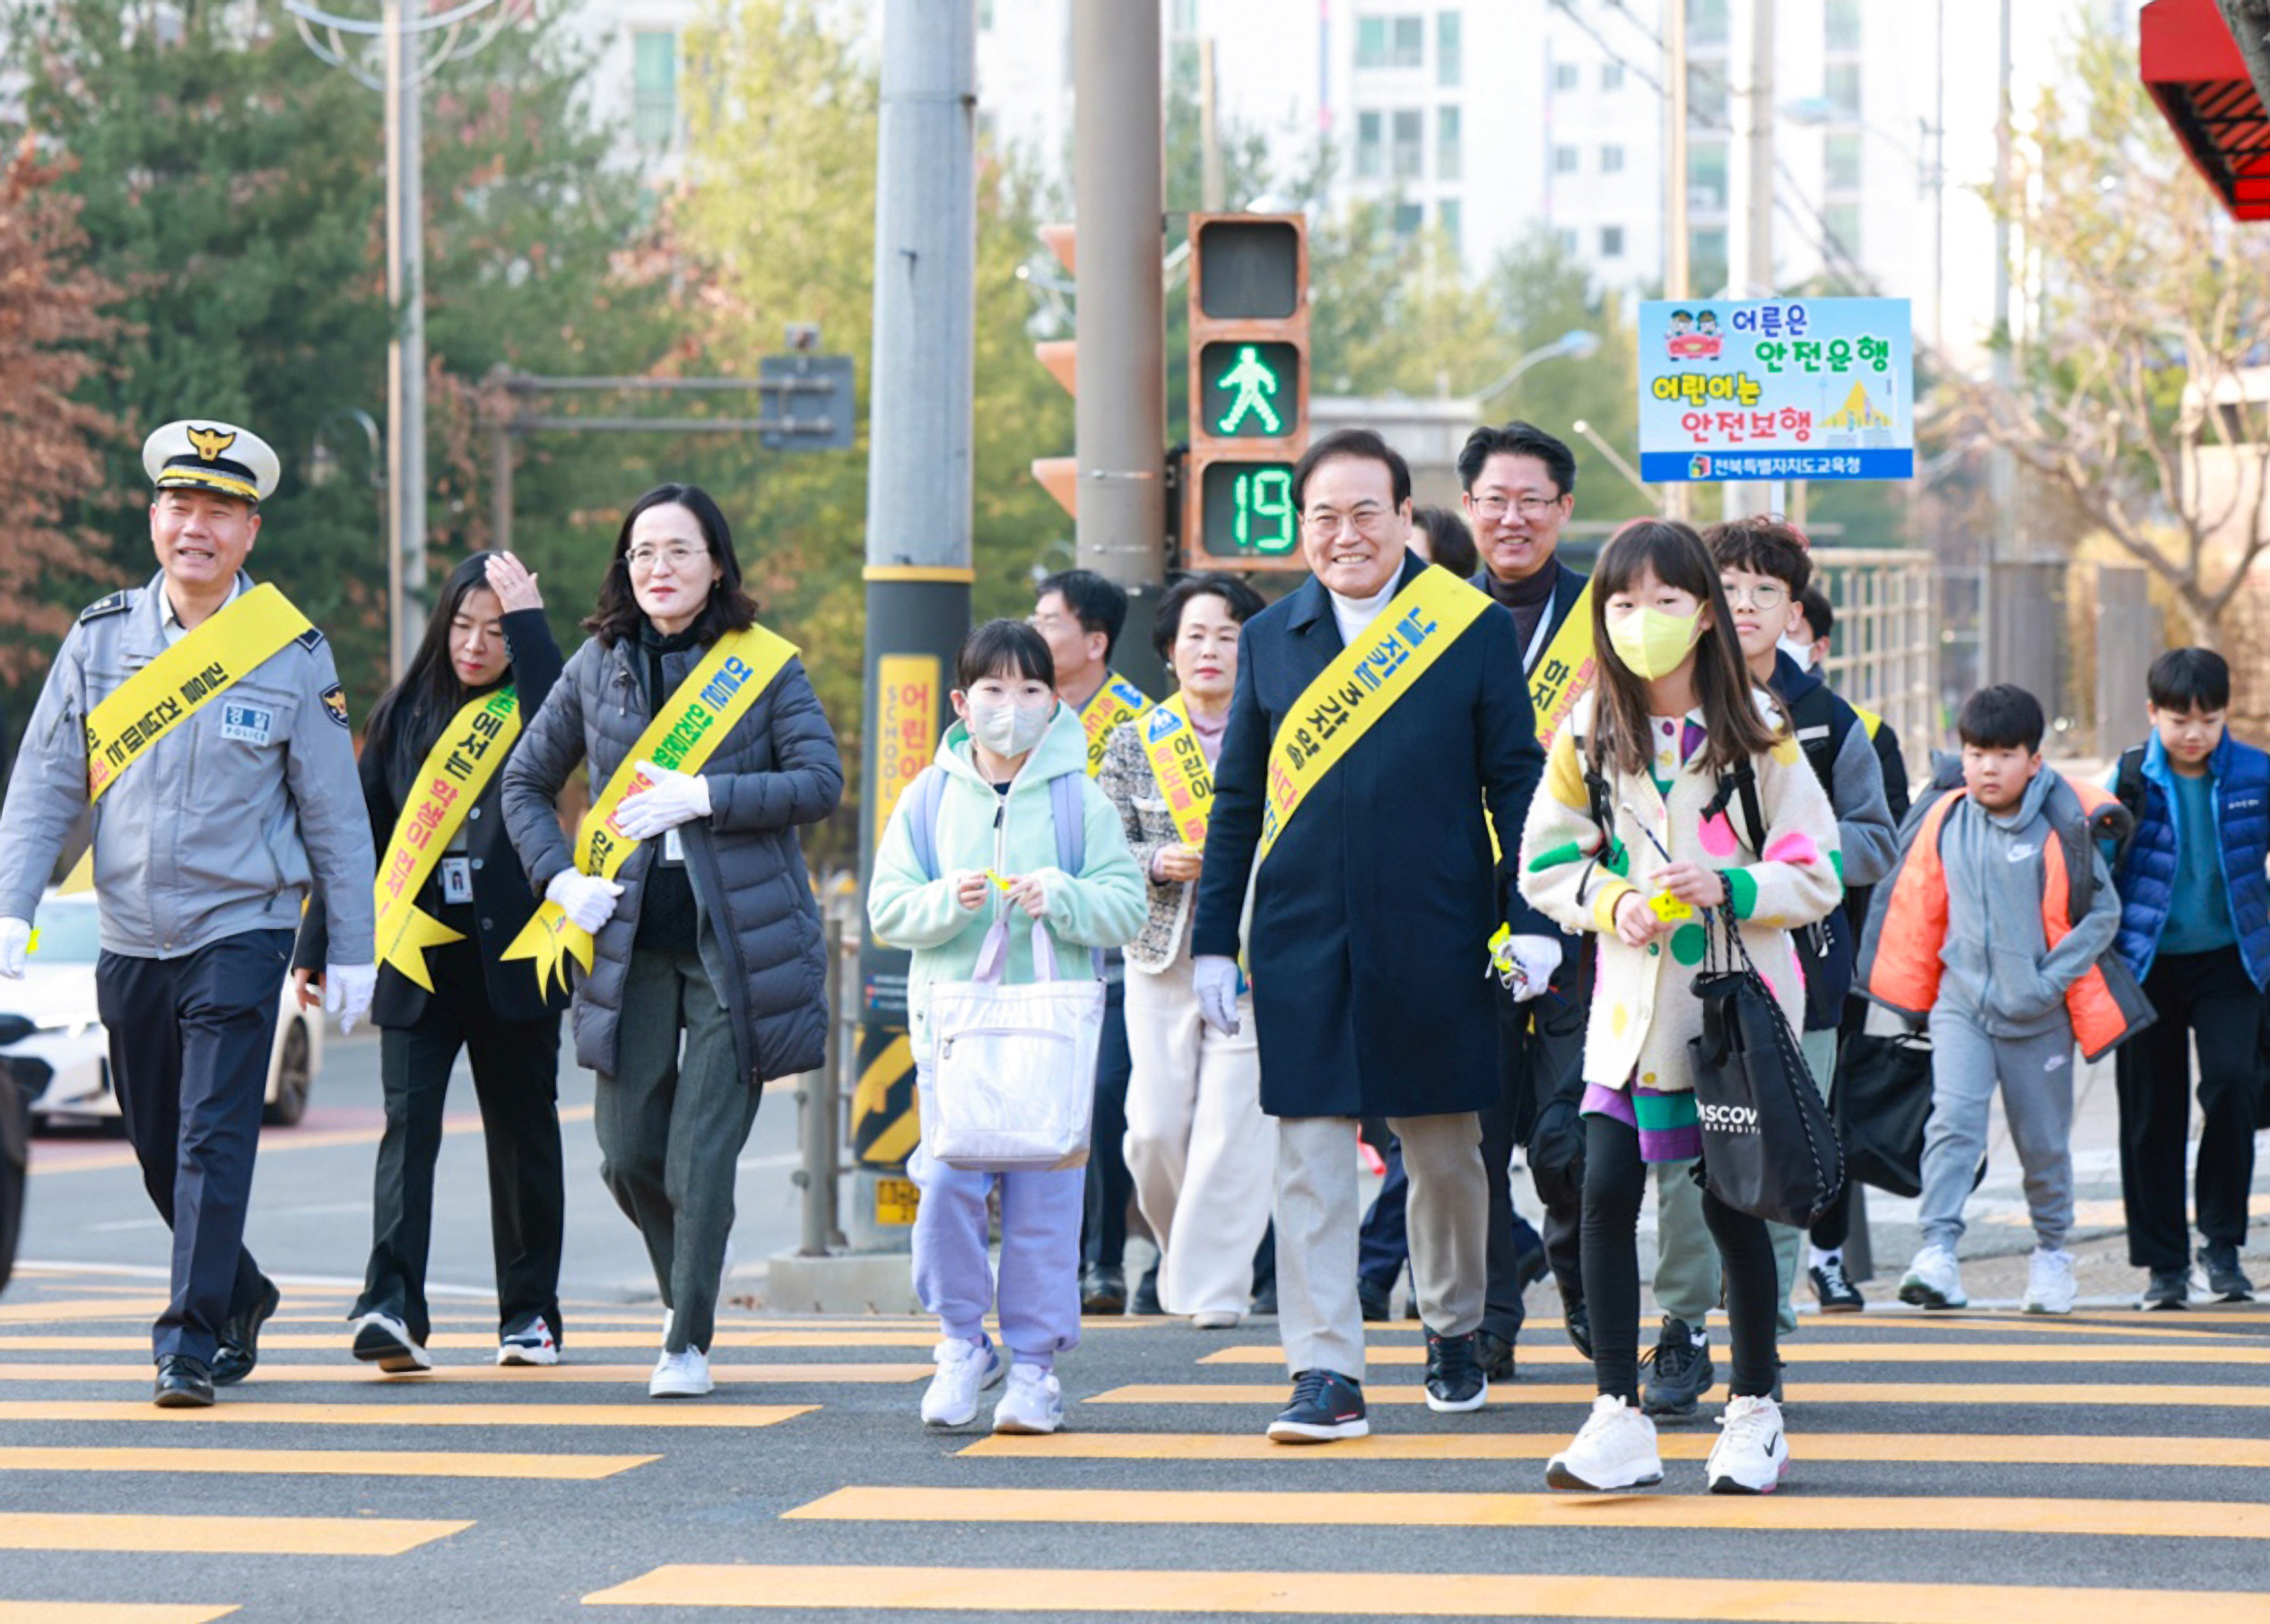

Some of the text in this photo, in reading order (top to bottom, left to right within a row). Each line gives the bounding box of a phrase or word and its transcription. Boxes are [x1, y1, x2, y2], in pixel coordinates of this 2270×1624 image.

[1733, 305, 1807, 337] 어른은
[1756, 336, 1889, 372] 안전운행
[1653, 372, 1761, 407] 어린이는
[1682, 406, 1812, 442] 안전보행
[1235, 470, 1293, 551] 19
[1353, 633, 1410, 692] 지키는
[226, 727, 265, 742] POLICE
[883, 684, 898, 799] SCHOOL
[1174, 734, 1214, 800] 어린이
[406, 778, 459, 852] 학생이
